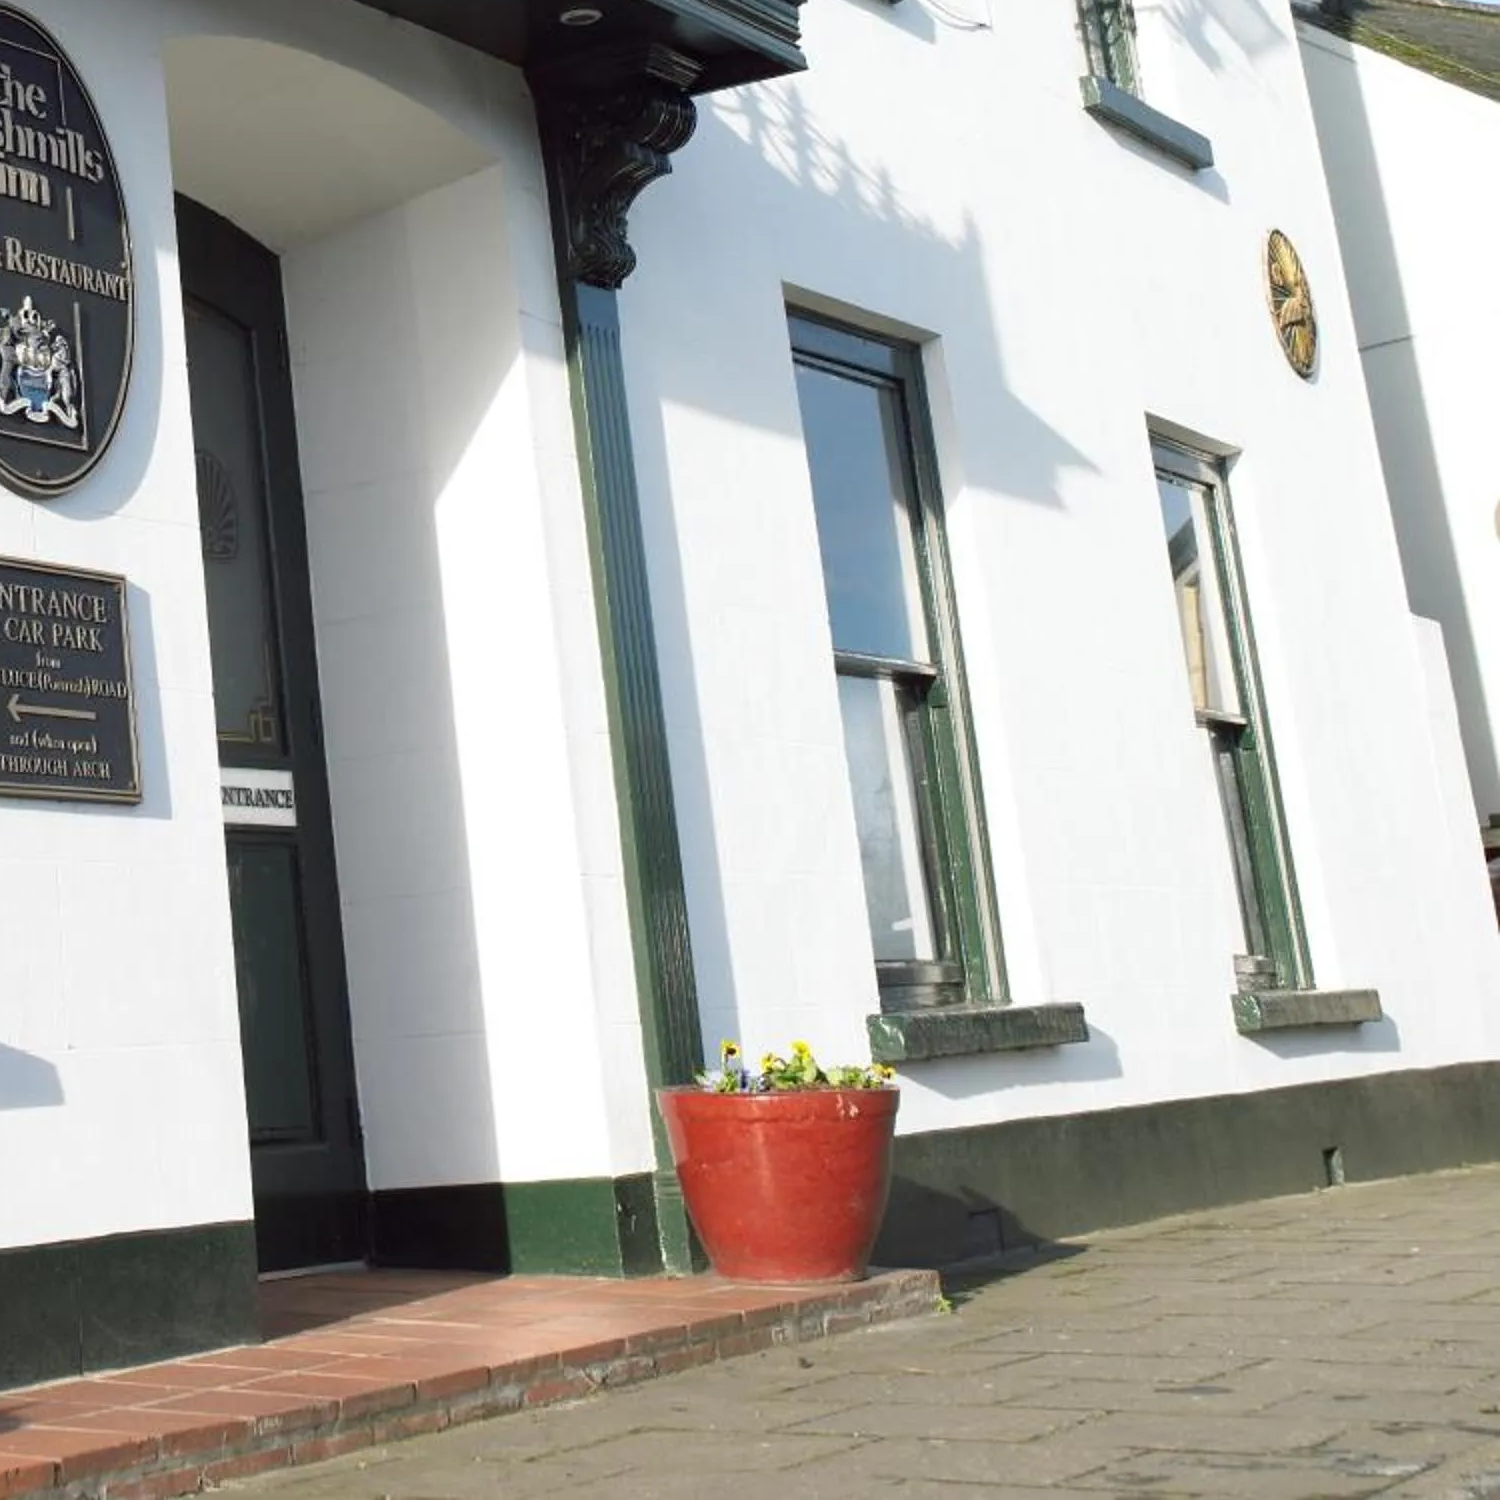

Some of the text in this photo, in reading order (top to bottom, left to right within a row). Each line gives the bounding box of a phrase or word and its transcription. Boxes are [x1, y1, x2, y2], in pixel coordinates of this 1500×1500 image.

[4, 236, 130, 301] RESTAURANT
[3, 616, 46, 645] CAR
[52, 622, 105, 651] PARK
[73, 760, 111, 780] ARCH
[220, 786, 293, 809] NTRANCE
